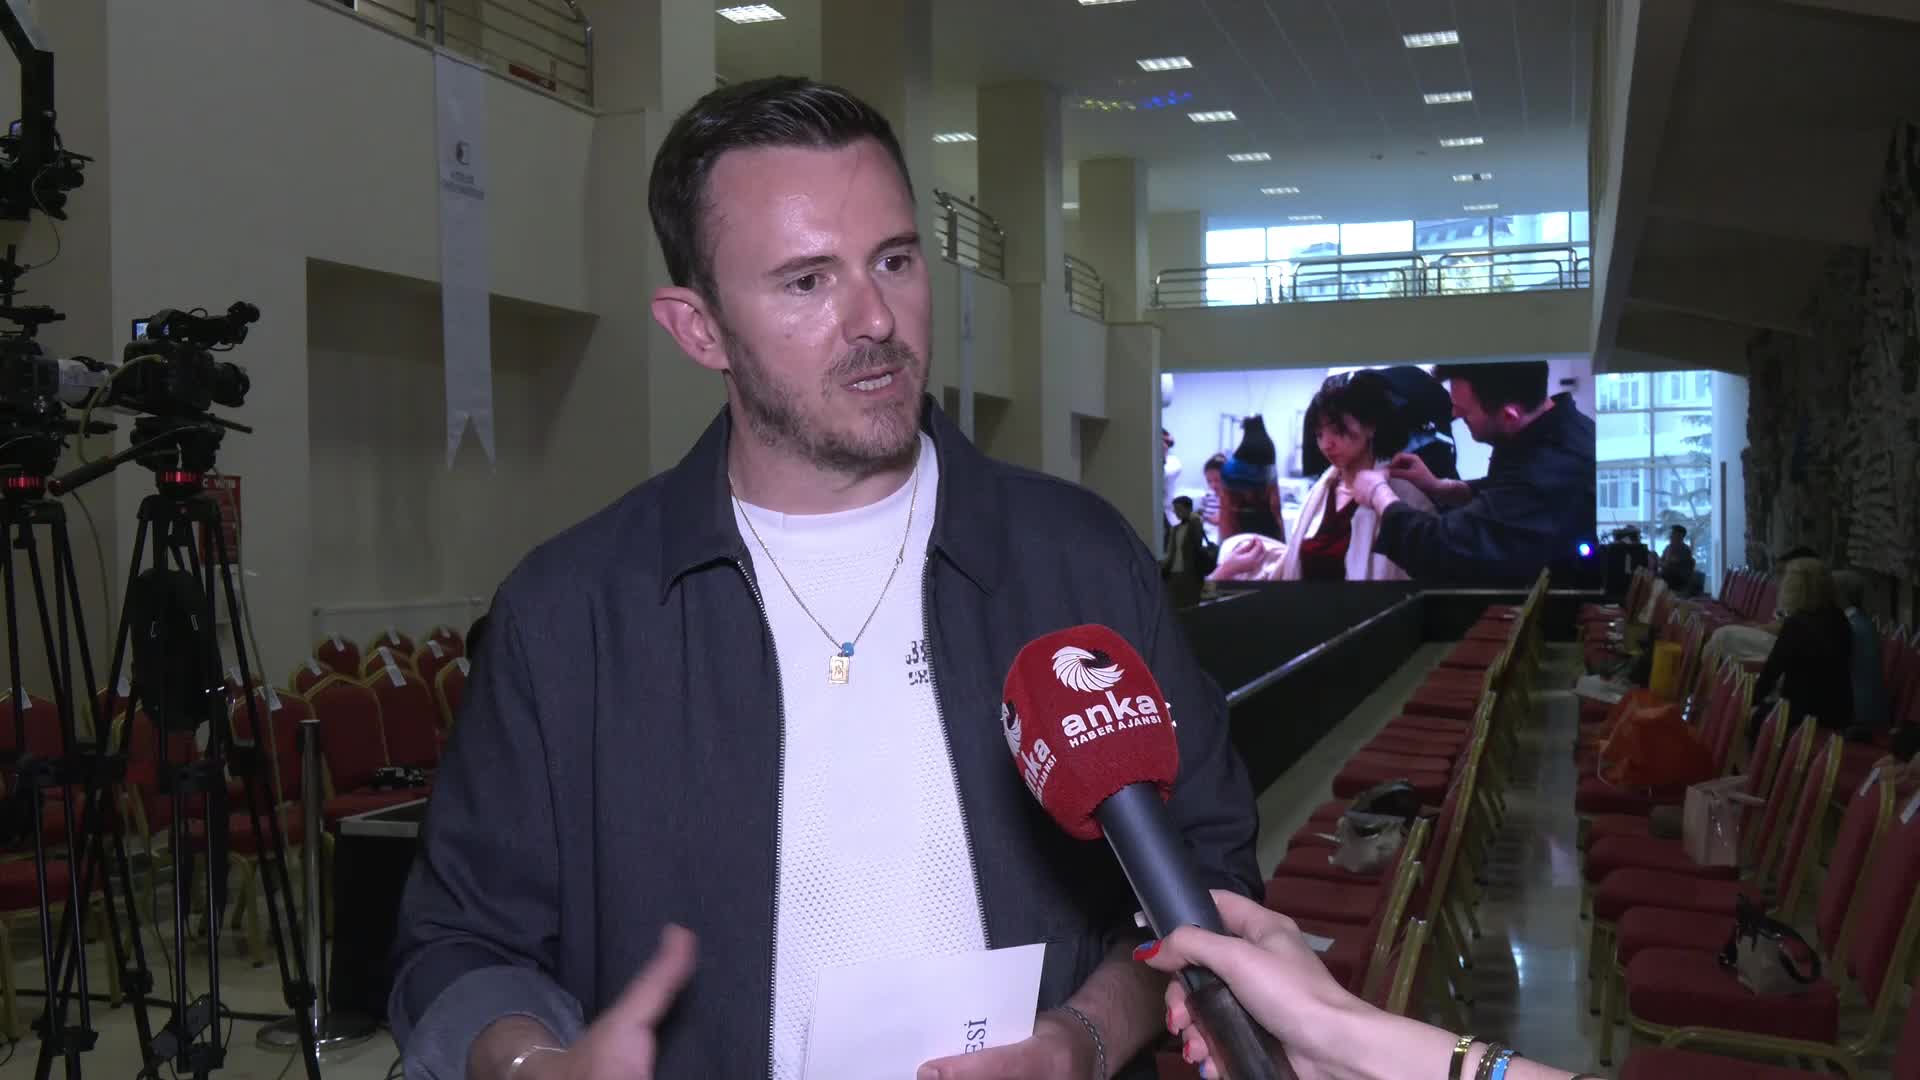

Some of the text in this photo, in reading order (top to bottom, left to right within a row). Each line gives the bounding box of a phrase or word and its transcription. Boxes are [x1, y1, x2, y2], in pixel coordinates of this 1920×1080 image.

[1061, 690, 1158, 737] anka
[1068, 724, 1115, 748] HABER
[1118, 715, 1162, 730] AJANSI
[1021, 738, 1051, 798] nka
